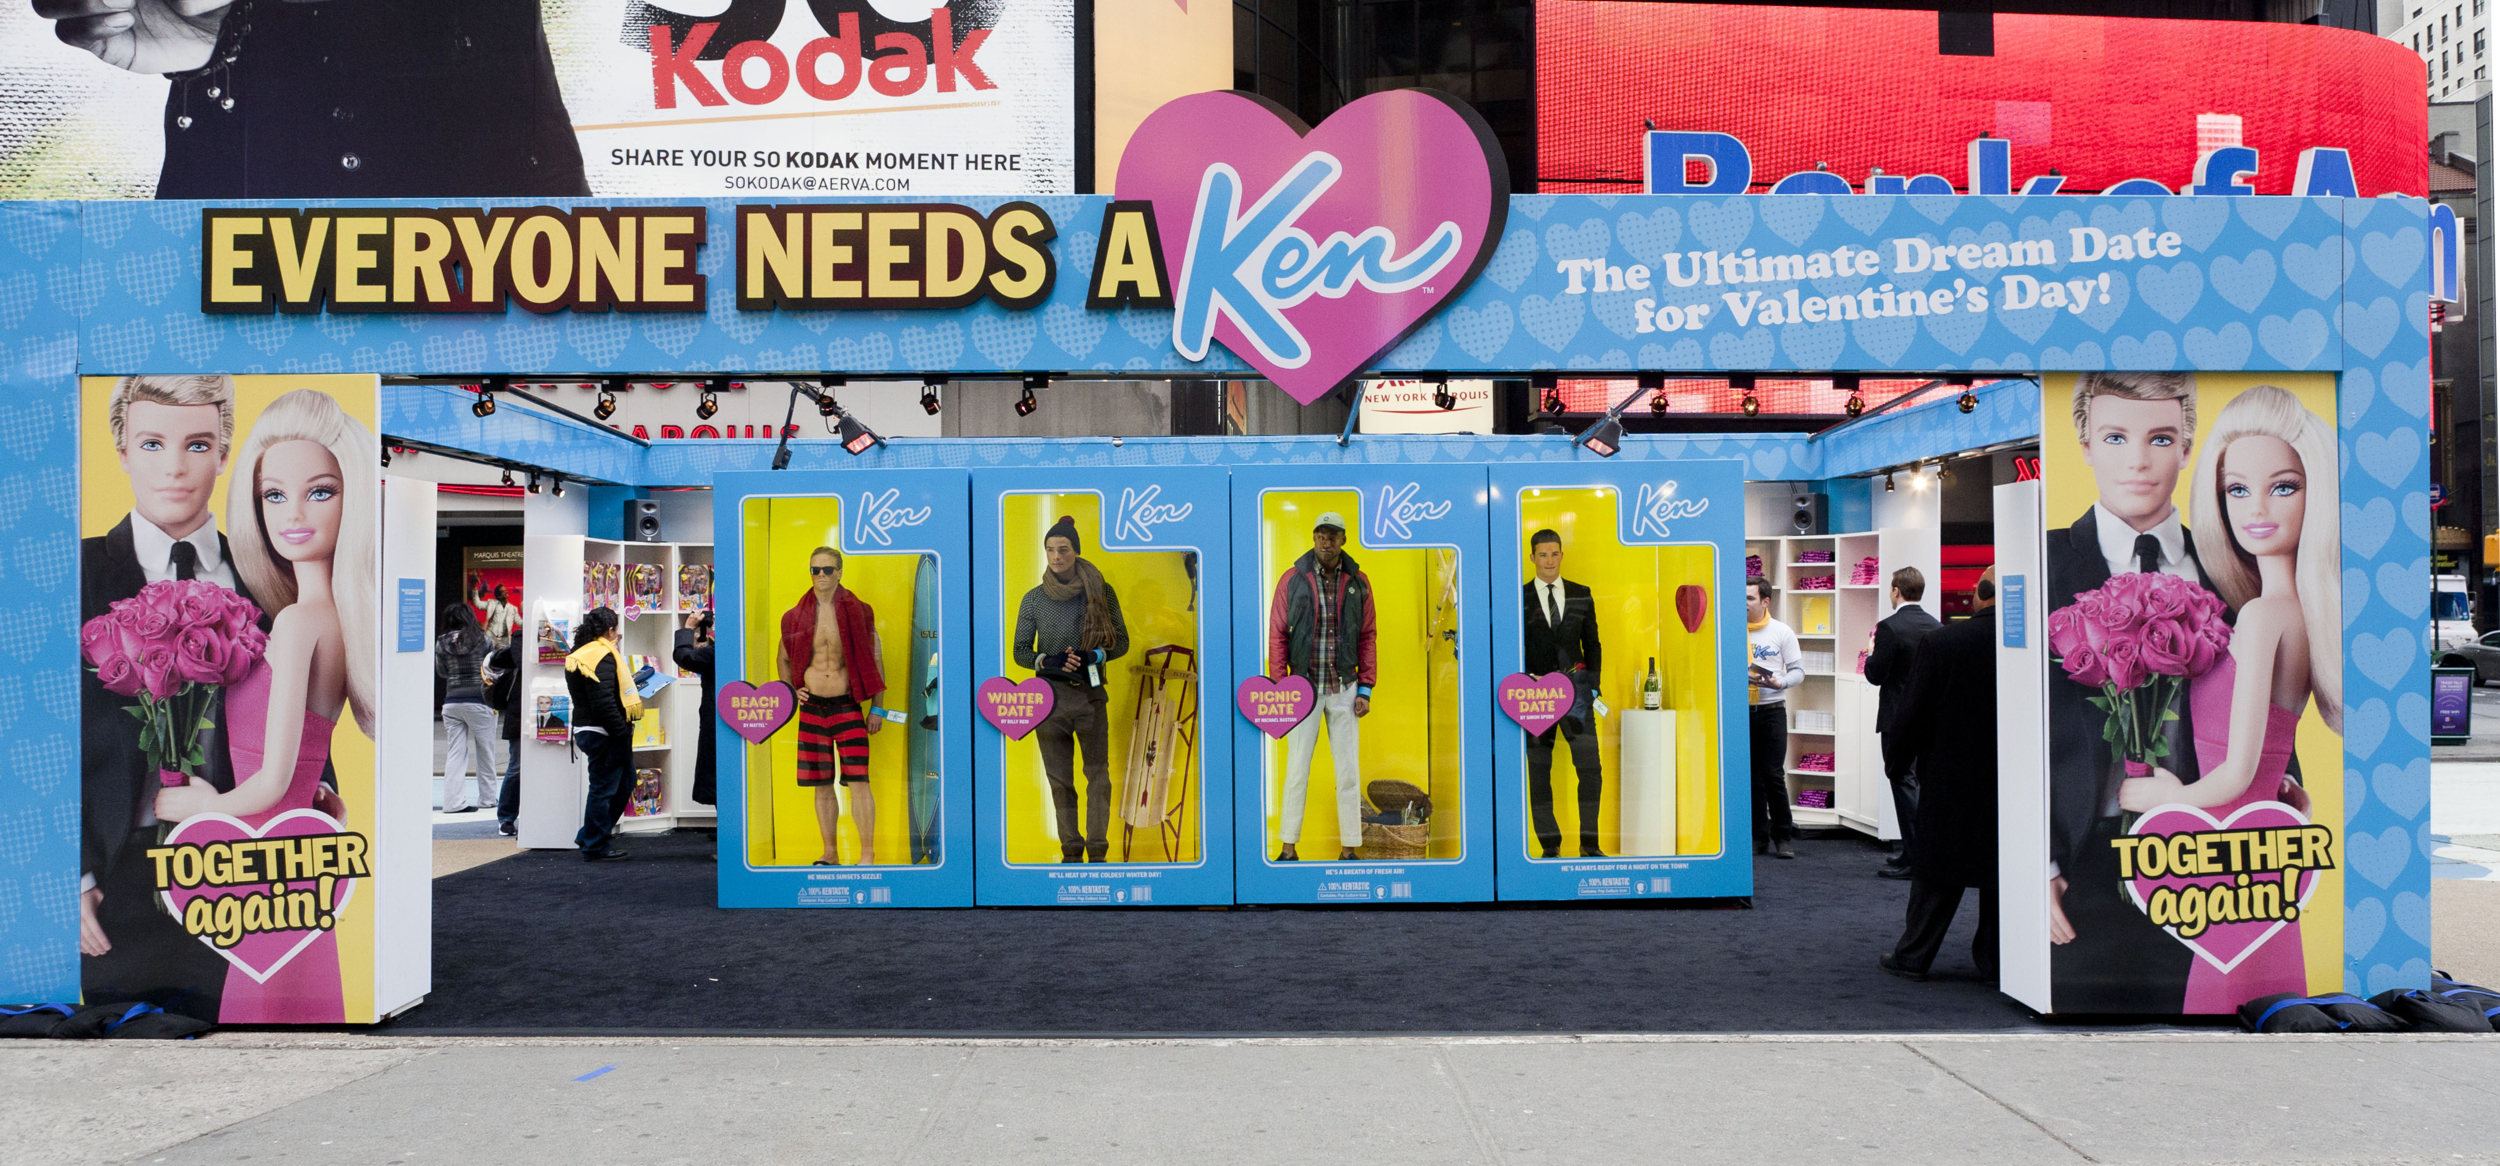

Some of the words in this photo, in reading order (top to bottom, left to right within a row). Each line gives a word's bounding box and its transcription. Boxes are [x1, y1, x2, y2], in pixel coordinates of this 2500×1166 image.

[649, 7, 1000, 109] Kodak
[611, 149, 684, 166] SHARE
[690, 150, 747, 167] YOUR
[753, 151, 781, 168] SO
[786, 151, 859, 169] KODAK
[866, 153, 959, 170] MOMENT
[965, 154, 1021, 171] HERE
[725, 176, 910, 191] SOKODAK@AERVA.COM
[208, 211, 698, 306] EVERYONE
[742, 207, 1049, 301] NEEDS
[1096, 209, 1164, 300] A
[1173, 151, 1463, 369] Ken
[1557, 257, 1650, 294] The
[1662, 245, 1880, 287] Ultimate
[1893, 237, 2057, 273] Dream
[2068, 226, 2182, 263] Date
[1635, 298, 1710, 333] for
[1721, 278, 1989, 327] Valentine's
[2001, 272, 2111, 315] Day!
[1364, 395, 1390, 403] NEW
[1395, 393, 1427, 402] YORK
[1115, 484, 1192, 542] Ken
[1375, 482, 1452, 539] Ken
[1633, 480, 1709, 538] Ken
[855, 488, 931, 546] Ken
[474, 551, 499, 559] MARQUIS
[987, 692, 1044, 704] WINTER
[1249, 690, 1302, 703] PICNIC
[1507, 687, 1567, 700] FORMAL
[731, 696, 779, 708] BEACH
[1519, 700, 1555, 713] DATE
[737, 709, 774, 720] DATE
[997, 705, 1034, 717] DATE
[1257, 703, 1294, 716] DATE
[2111, 826, 2333, 879] TOGETHER
[146, 834, 369, 889] TOGETHER
[1328, 882, 1341, 890] 100%
[1588, 878, 1601, 886] 100%
[808, 887, 821, 895] 100%
[1068, 885, 1081, 894] 100%
[2149, 867, 2300, 938] again!
[184, 876, 336, 948] again!
